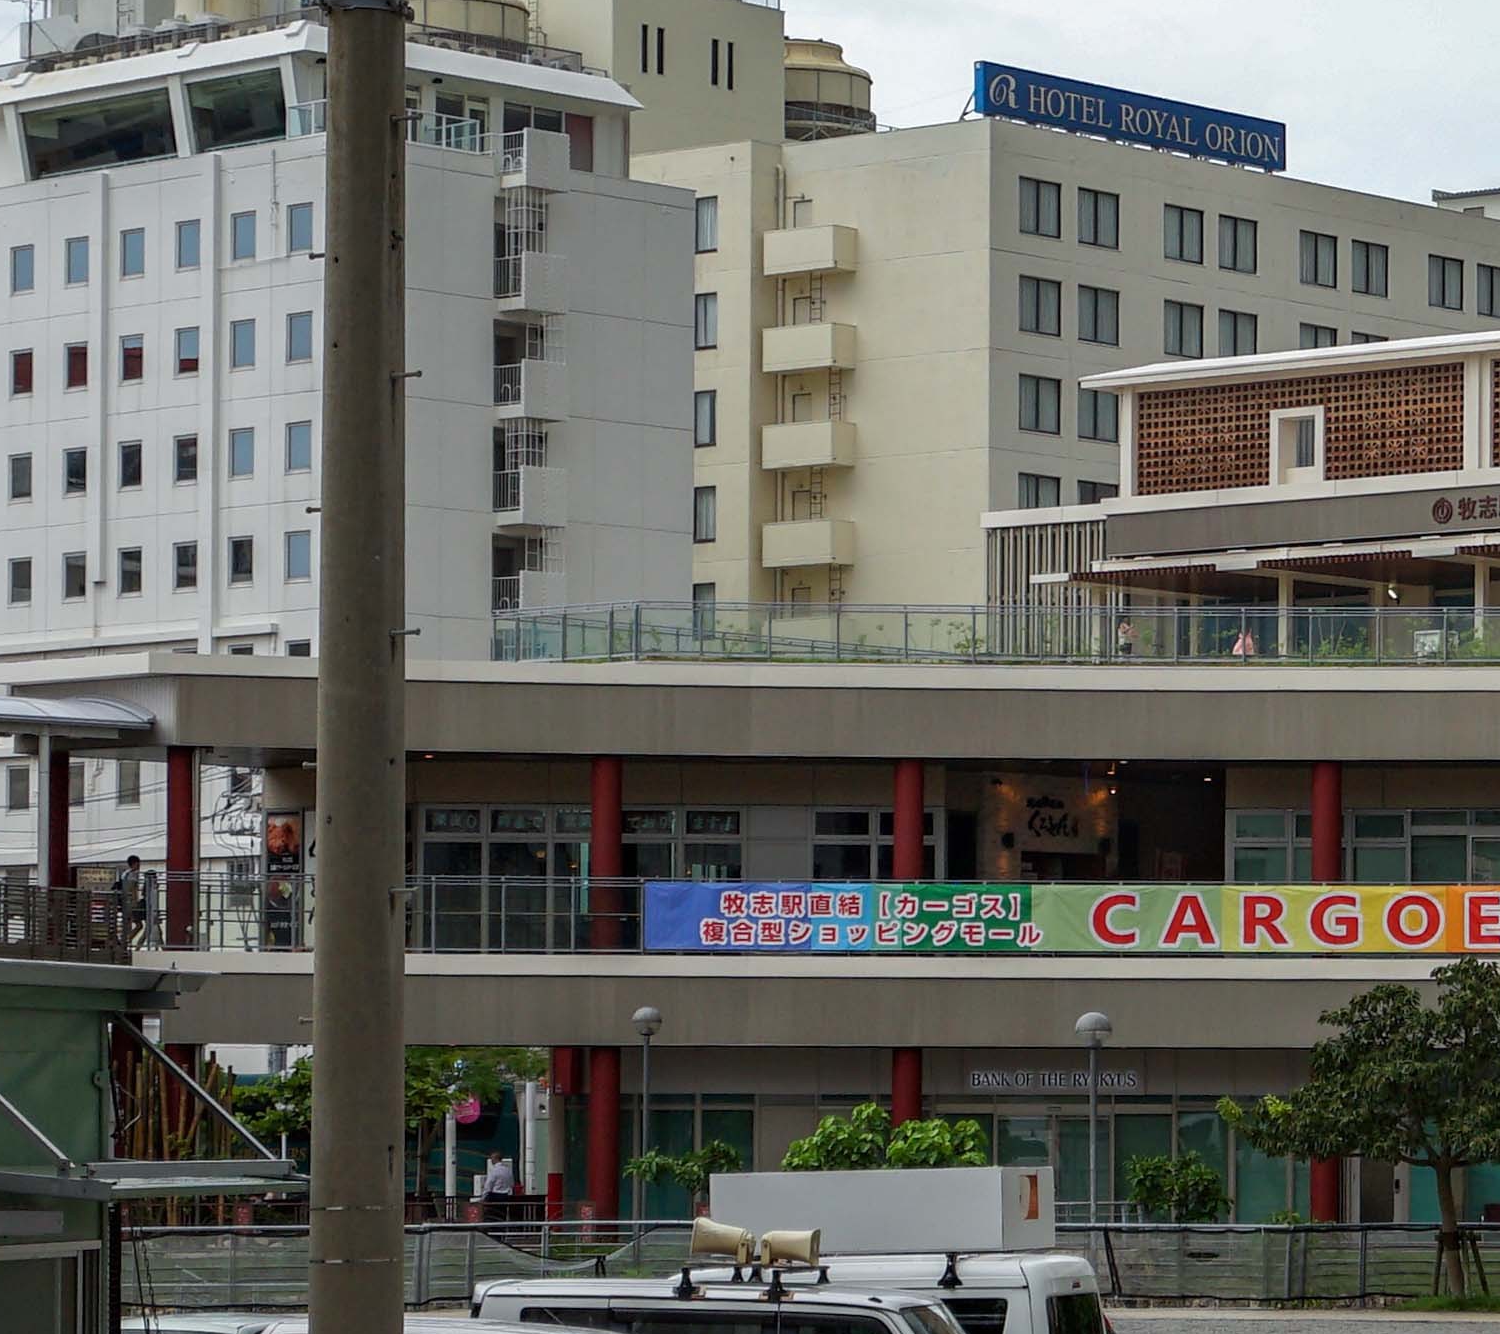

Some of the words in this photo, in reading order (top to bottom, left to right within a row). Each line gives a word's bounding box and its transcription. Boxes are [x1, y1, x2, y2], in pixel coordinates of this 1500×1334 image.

[1028, 84, 1112, 129] HOTEL
[1119, 103, 1199, 147] ROYAL
[1205, 123, 1280, 162] ORION
[701, 919, 1043, 947] 複合型ショッピングモール
[971, 1072, 1010, 1087] BANK
[1014, 1072, 1034, 1087] OF
[1040, 1072, 1068, 1087] THE
[1072, 1072, 1137, 1087] RYKYUS
